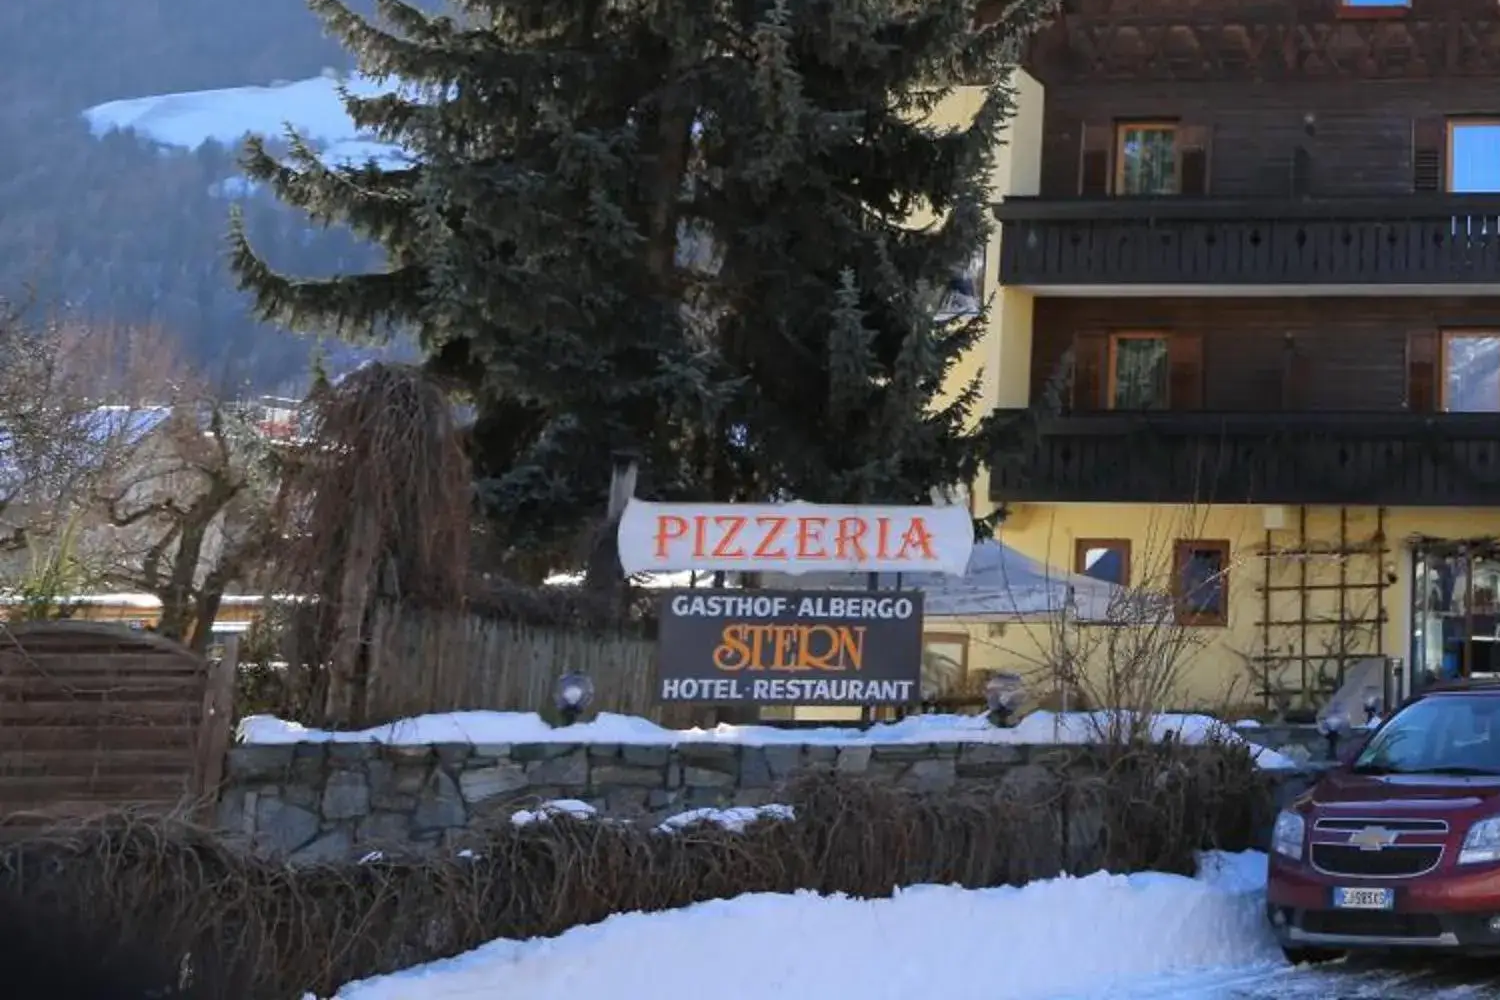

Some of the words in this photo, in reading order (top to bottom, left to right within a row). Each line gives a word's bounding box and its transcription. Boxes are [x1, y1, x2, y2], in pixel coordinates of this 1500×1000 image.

[654, 514, 939, 561] PIZZERIA
[671, 595, 787, 617] GASTHOF
[798, 597, 913, 618] ALBERGO
[712, 623, 867, 672] STERN
[662, 679, 744, 699] HOTEL
[753, 680, 913, 700] RESTAURANT
